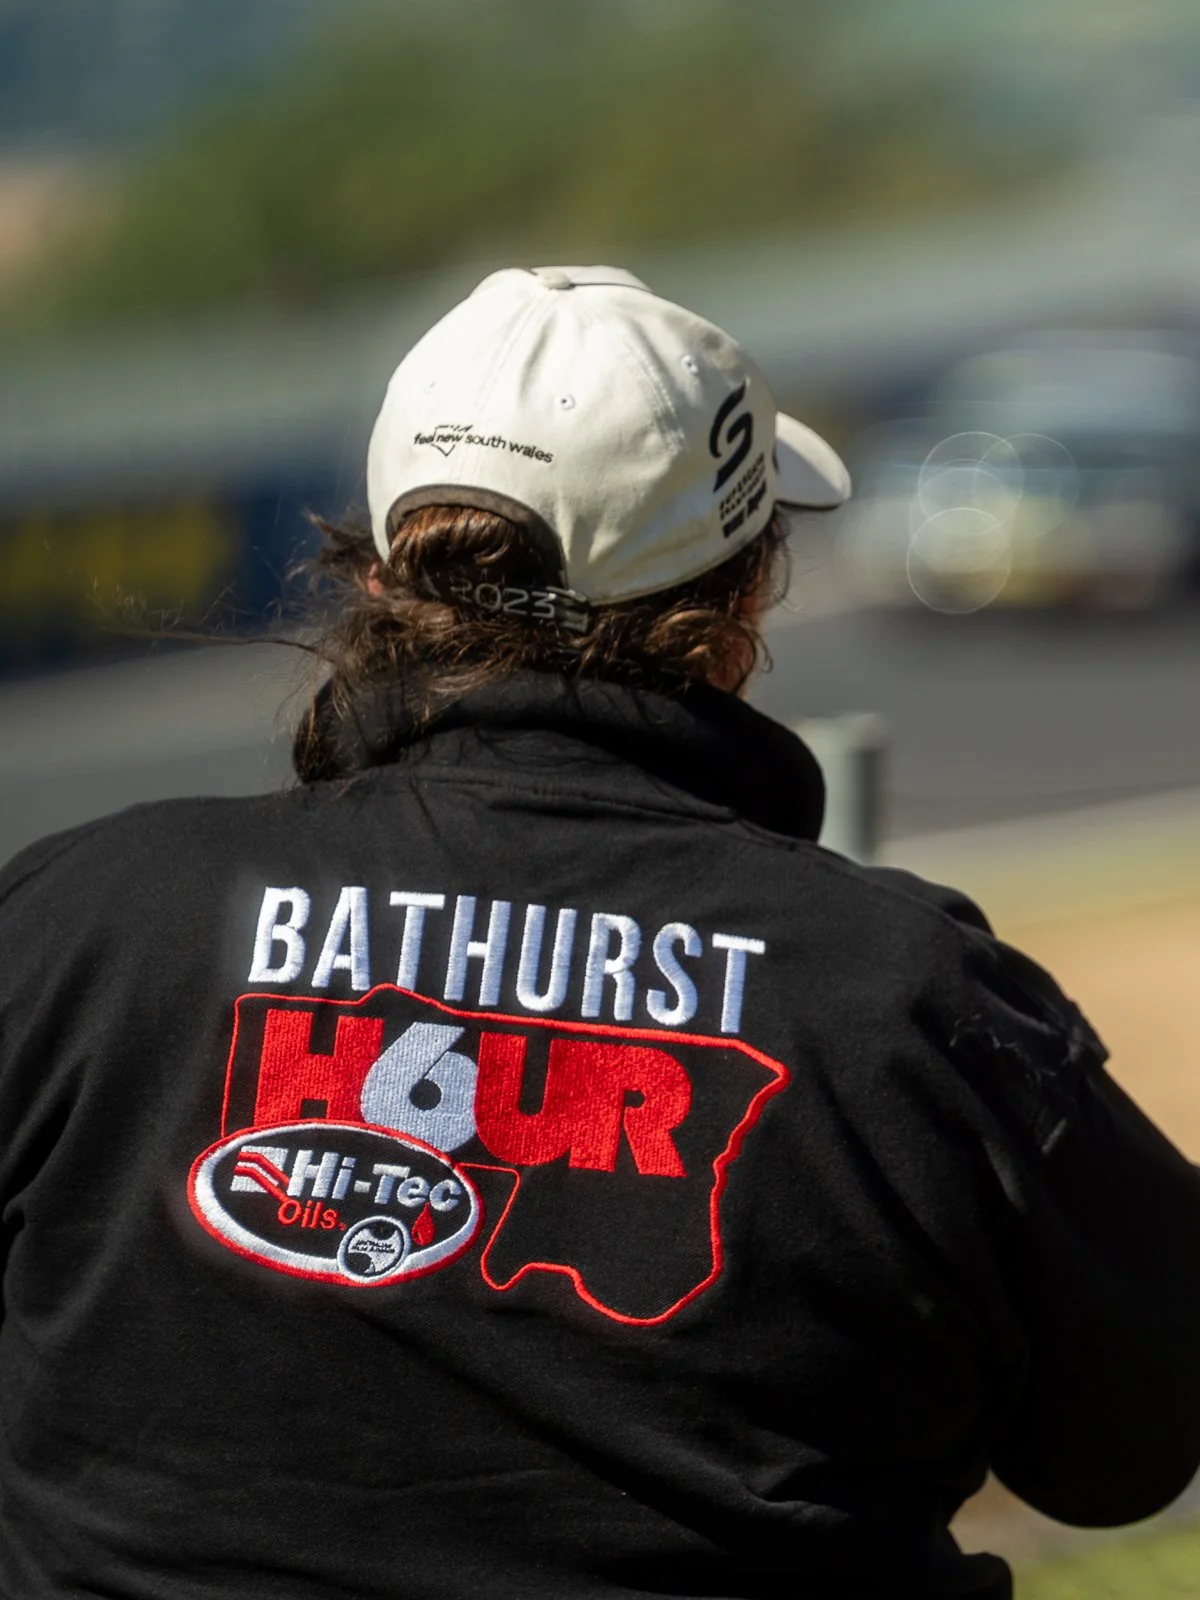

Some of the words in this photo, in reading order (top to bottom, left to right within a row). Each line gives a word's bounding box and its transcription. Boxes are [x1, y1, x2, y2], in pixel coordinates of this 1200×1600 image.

[413, 432, 436, 445] feel
[436, 433, 463, 444] new
[465, 434, 506, 449] south
[508, 440, 554, 463] wales
[449, 576, 556, 619] 2023
[247, 886, 766, 1034] BATHURST
[286, 1149, 462, 1212] Hi-Tec
[277, 1199, 338, 1230] Oils
